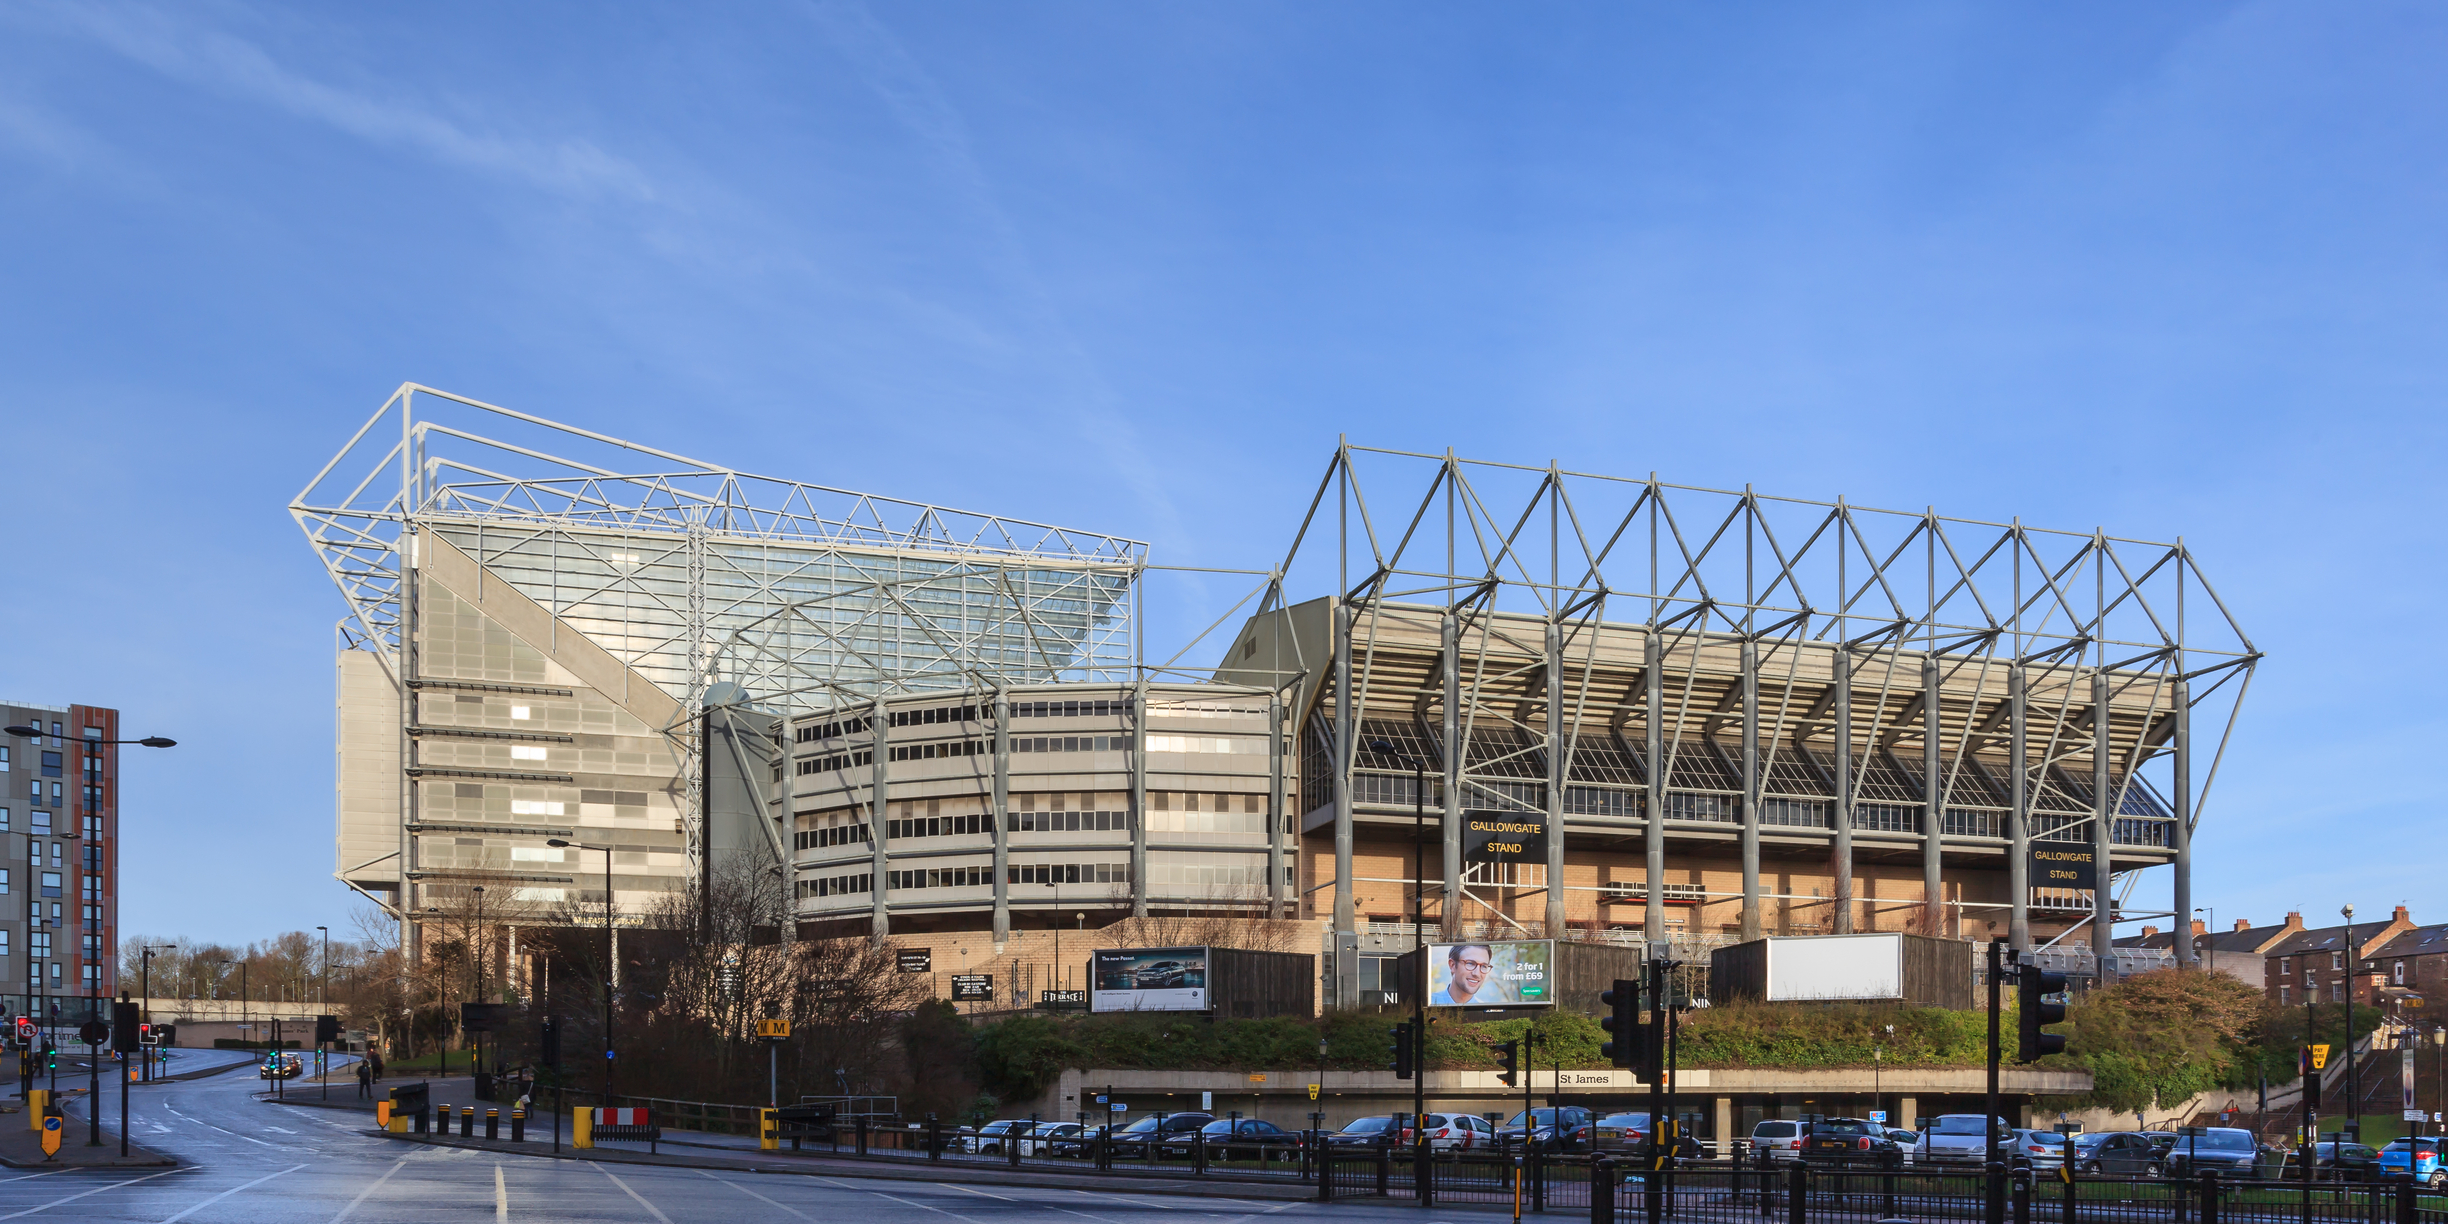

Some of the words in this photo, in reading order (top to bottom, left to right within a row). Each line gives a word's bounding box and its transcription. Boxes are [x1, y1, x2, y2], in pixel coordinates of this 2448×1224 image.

[1470, 821, 1541, 834] GALLOWGATE
[1487, 842, 1522, 853] STAND
[2035, 850, 2092, 862] GALLOWGATE
[2050, 869, 2078, 880] STAND
[1516, 962, 1523, 971] 2
[1524, 962, 1538, 971] for
[1539, 962, 1543, 970] 1
[1503, 972, 1524, 981] from
[1525, 971, 1543, 980] £69
[1049, 992, 1079, 1002] TERRACE
[760, 1022, 768, 1034] M
[773, 1022, 786, 1034] M
[1560, 1074, 1572, 1084] St
[1575, 1074, 1609, 1084] James
